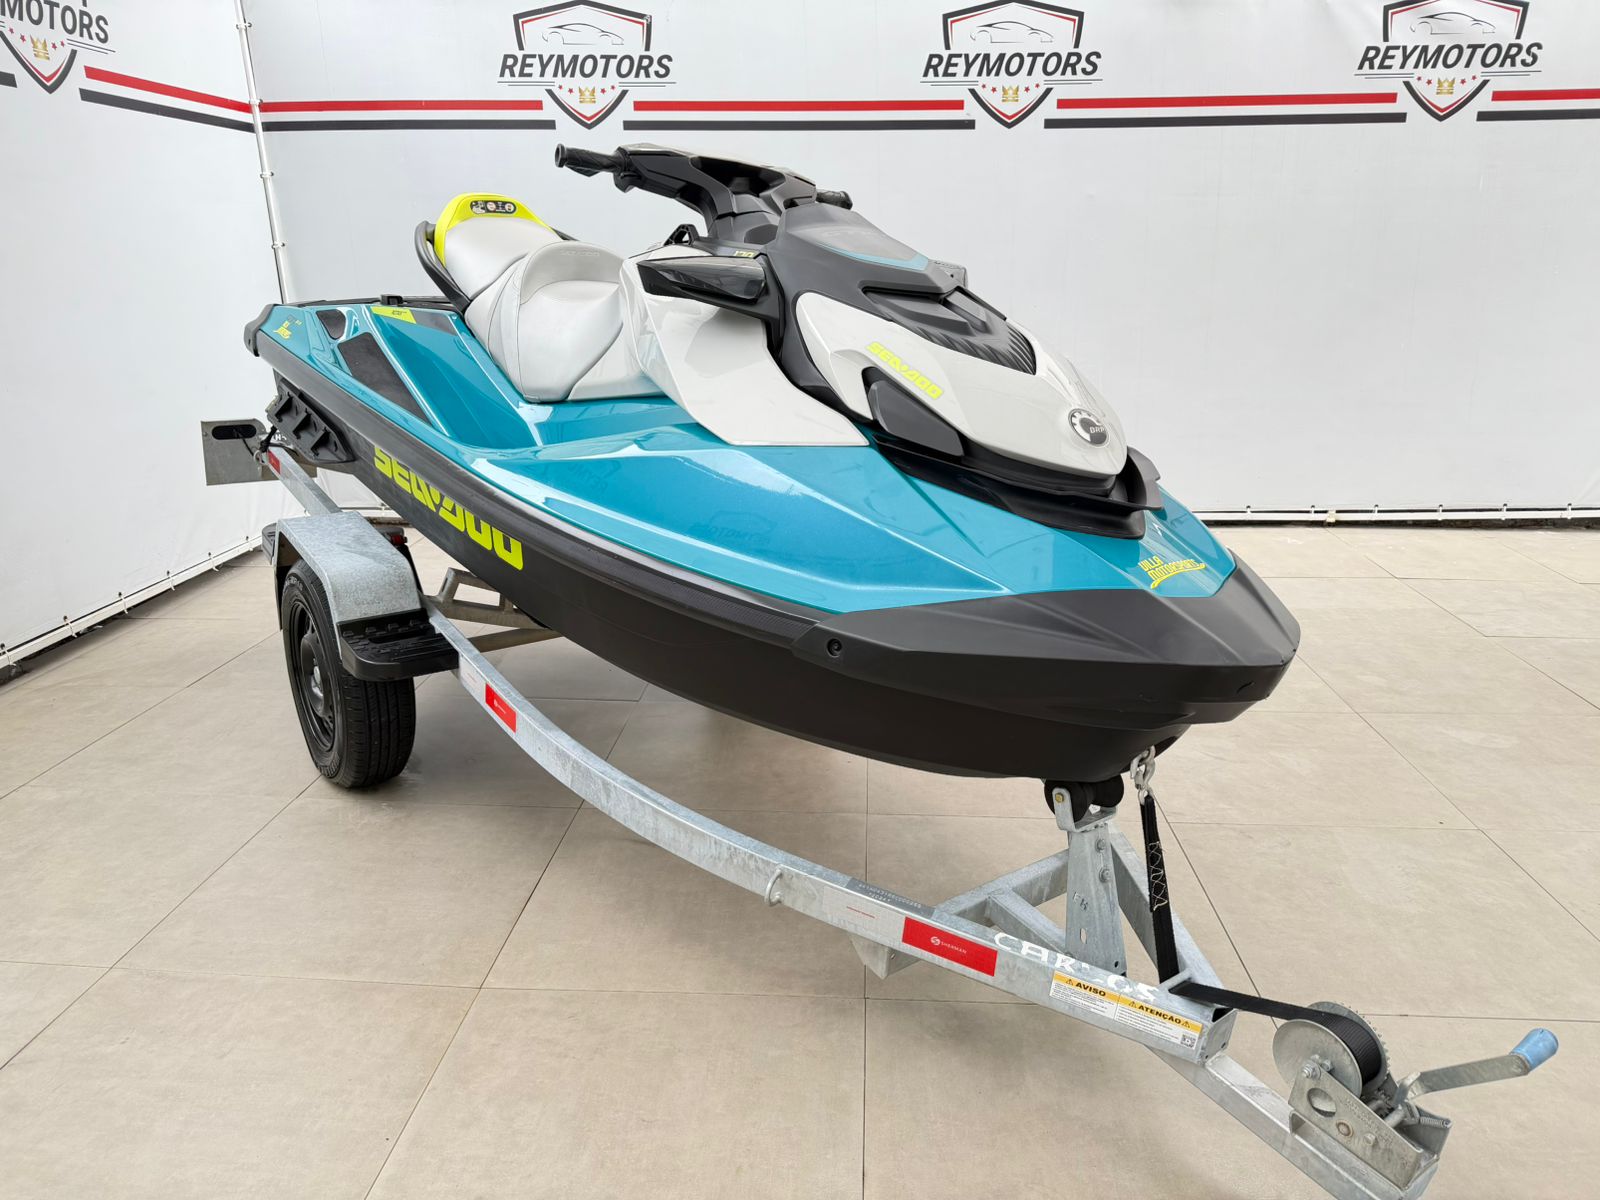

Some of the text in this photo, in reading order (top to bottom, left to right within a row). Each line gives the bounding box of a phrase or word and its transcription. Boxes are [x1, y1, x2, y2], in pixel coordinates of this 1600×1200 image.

[499, 53, 673, 79] REYMOTORS
[922, 51, 1102, 78] REYMOTORS
[1357, 42, 1543, 70] REYMOTORS
[1075, 981, 1107, 997] AVISO
